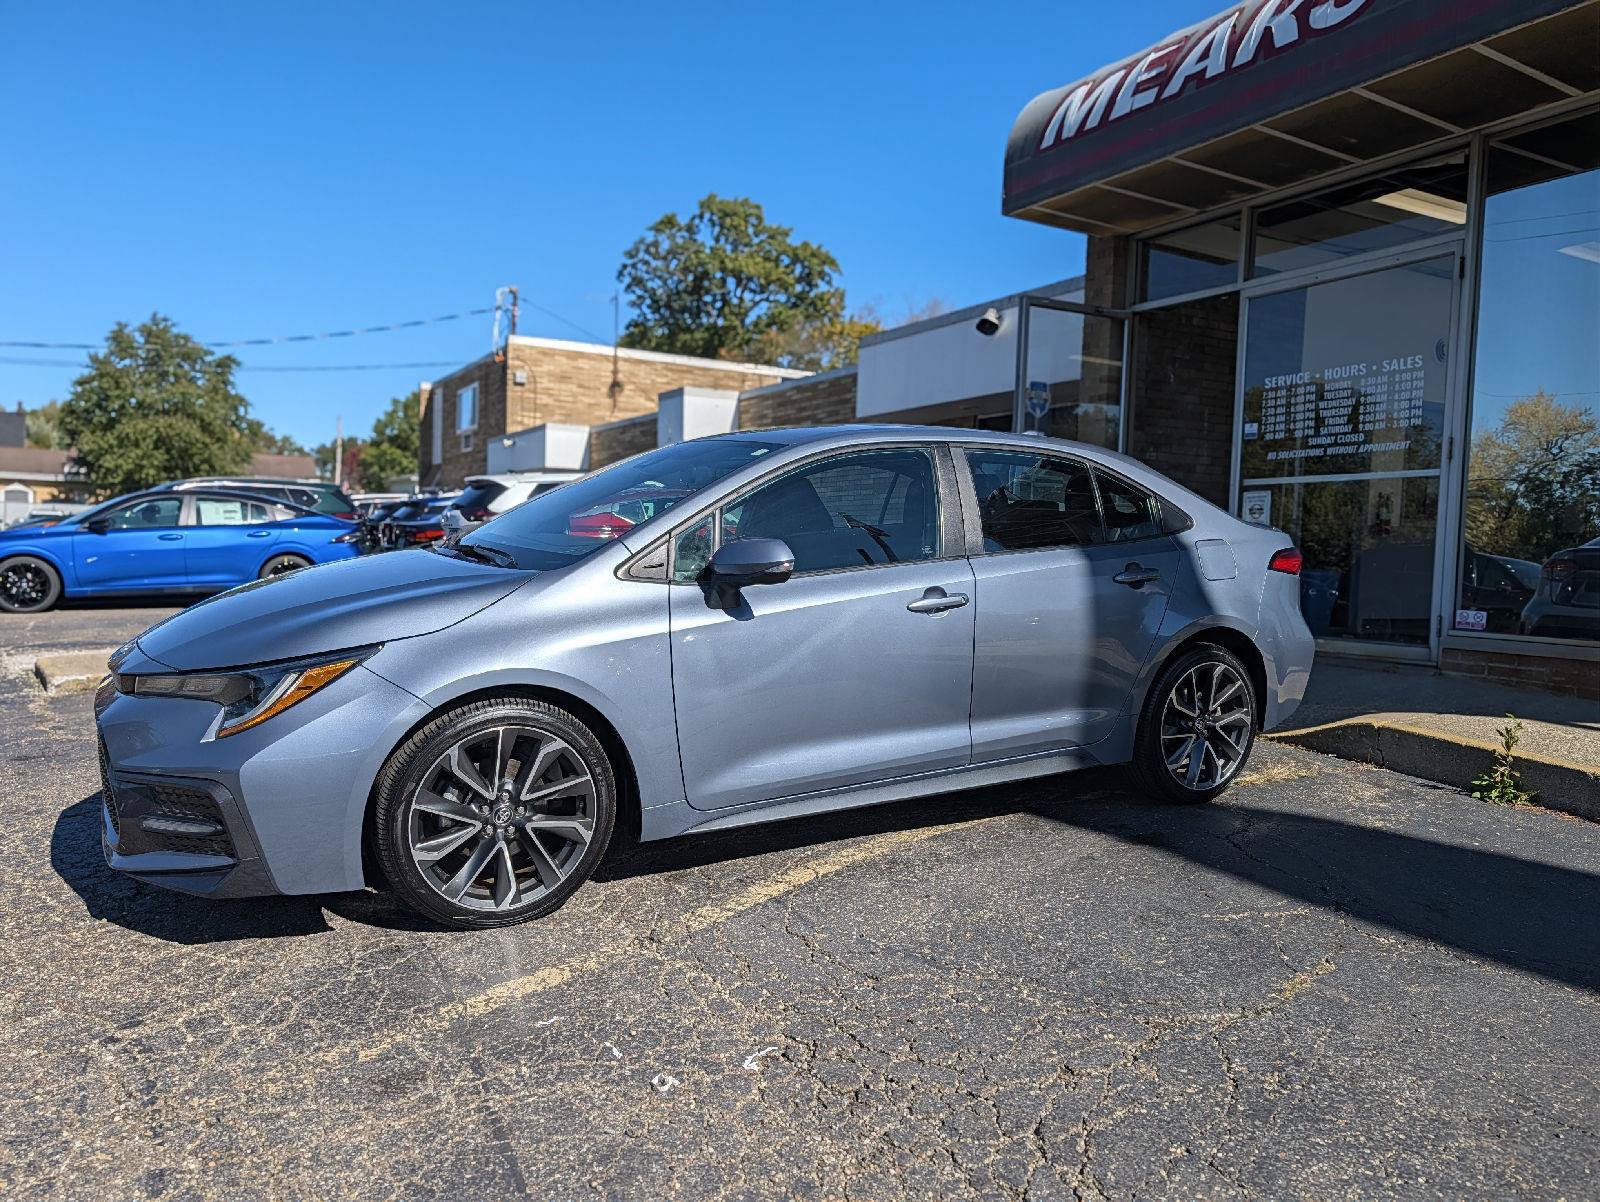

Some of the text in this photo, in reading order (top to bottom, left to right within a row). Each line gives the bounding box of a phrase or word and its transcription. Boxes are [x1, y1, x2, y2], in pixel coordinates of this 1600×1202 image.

[1264, 371, 1311, 389] SERVICE
[1324, 363, 1366, 380] HOURS
[1382, 355, 1423, 372] SALES
[1413, 370, 1424, 378] PM
[1324, 381, 1352, 391] MONDAY
[1413, 380, 1424, 388] PM
[1324, 390, 1352, 399] TUESDAY
[1412, 390, 1424, 398] PM
[1319, 397, 1356, 409] WEDNESDAY
[1411, 399, 1423, 408] PM
[1319, 407, 1352, 418] THURSDAY
[1411, 408, 1422, 417] PM
[1325, 416, 1348, 425] FRIDAY
[1411, 418, 1422, 426] PM
[1320, 424, 1353, 435] SATURDAY
[1308, 433, 1364, 446] SUNDAY CLOSED
[1278, 449, 1324, 459] SOLICITATIONS
[1326, 445, 1358, 455] WITHOUT
[1358, 440, 1411, 452] APPOINTMENT
